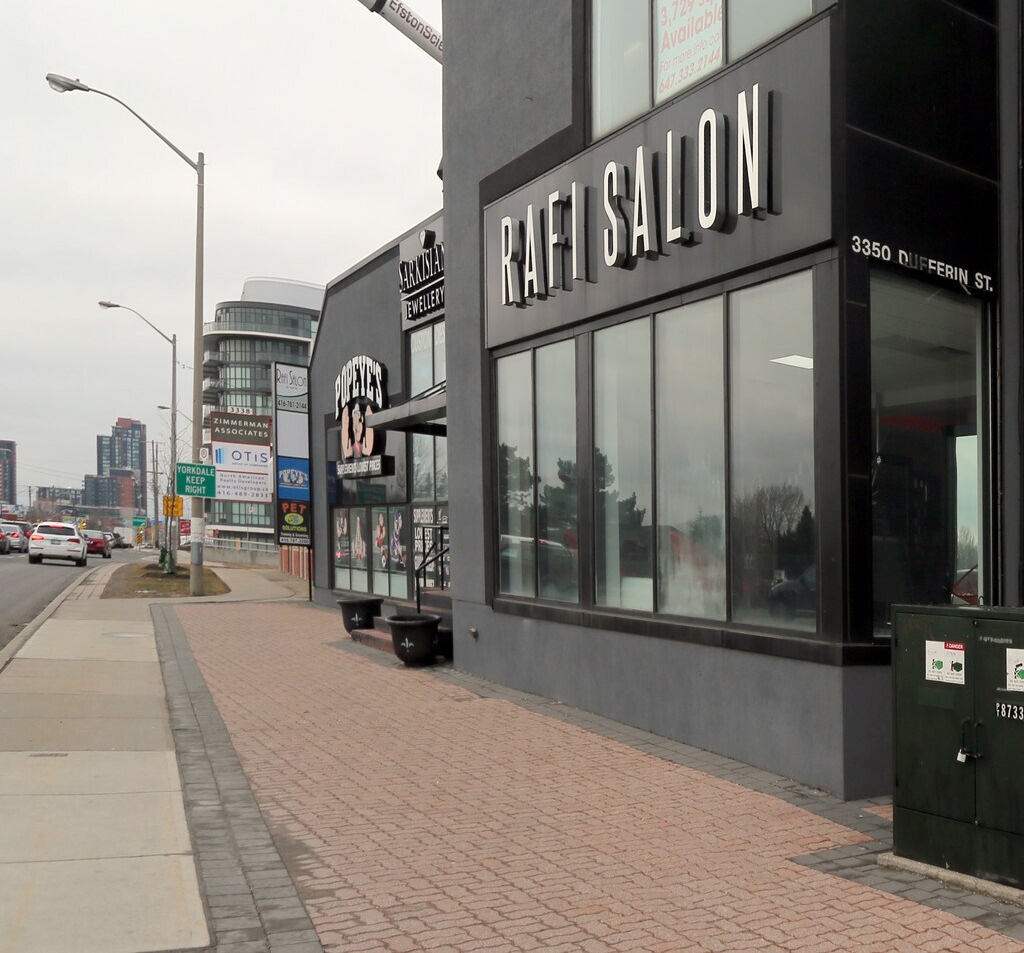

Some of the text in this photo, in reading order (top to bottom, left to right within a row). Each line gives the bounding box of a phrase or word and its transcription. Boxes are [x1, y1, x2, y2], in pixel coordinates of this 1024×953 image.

[661, 3, 723, 53] Available
[659, 48, 721, 94] 647.333.2144
[501, 83, 763, 307] RAFI SALON
[851, 235, 994, 292] 3350 DUFFERIN ST.
[335, 355, 383, 420] POPEYE'S
[213, 417, 268, 429] ZIMMERMAN
[214, 427, 268, 438] ASSOCIATES
[177, 466, 215, 476] YORKDALE
[185, 476, 205, 485] KEEP
[185, 485, 206, 494] RIGHT
[281, 502, 306, 514] PET
